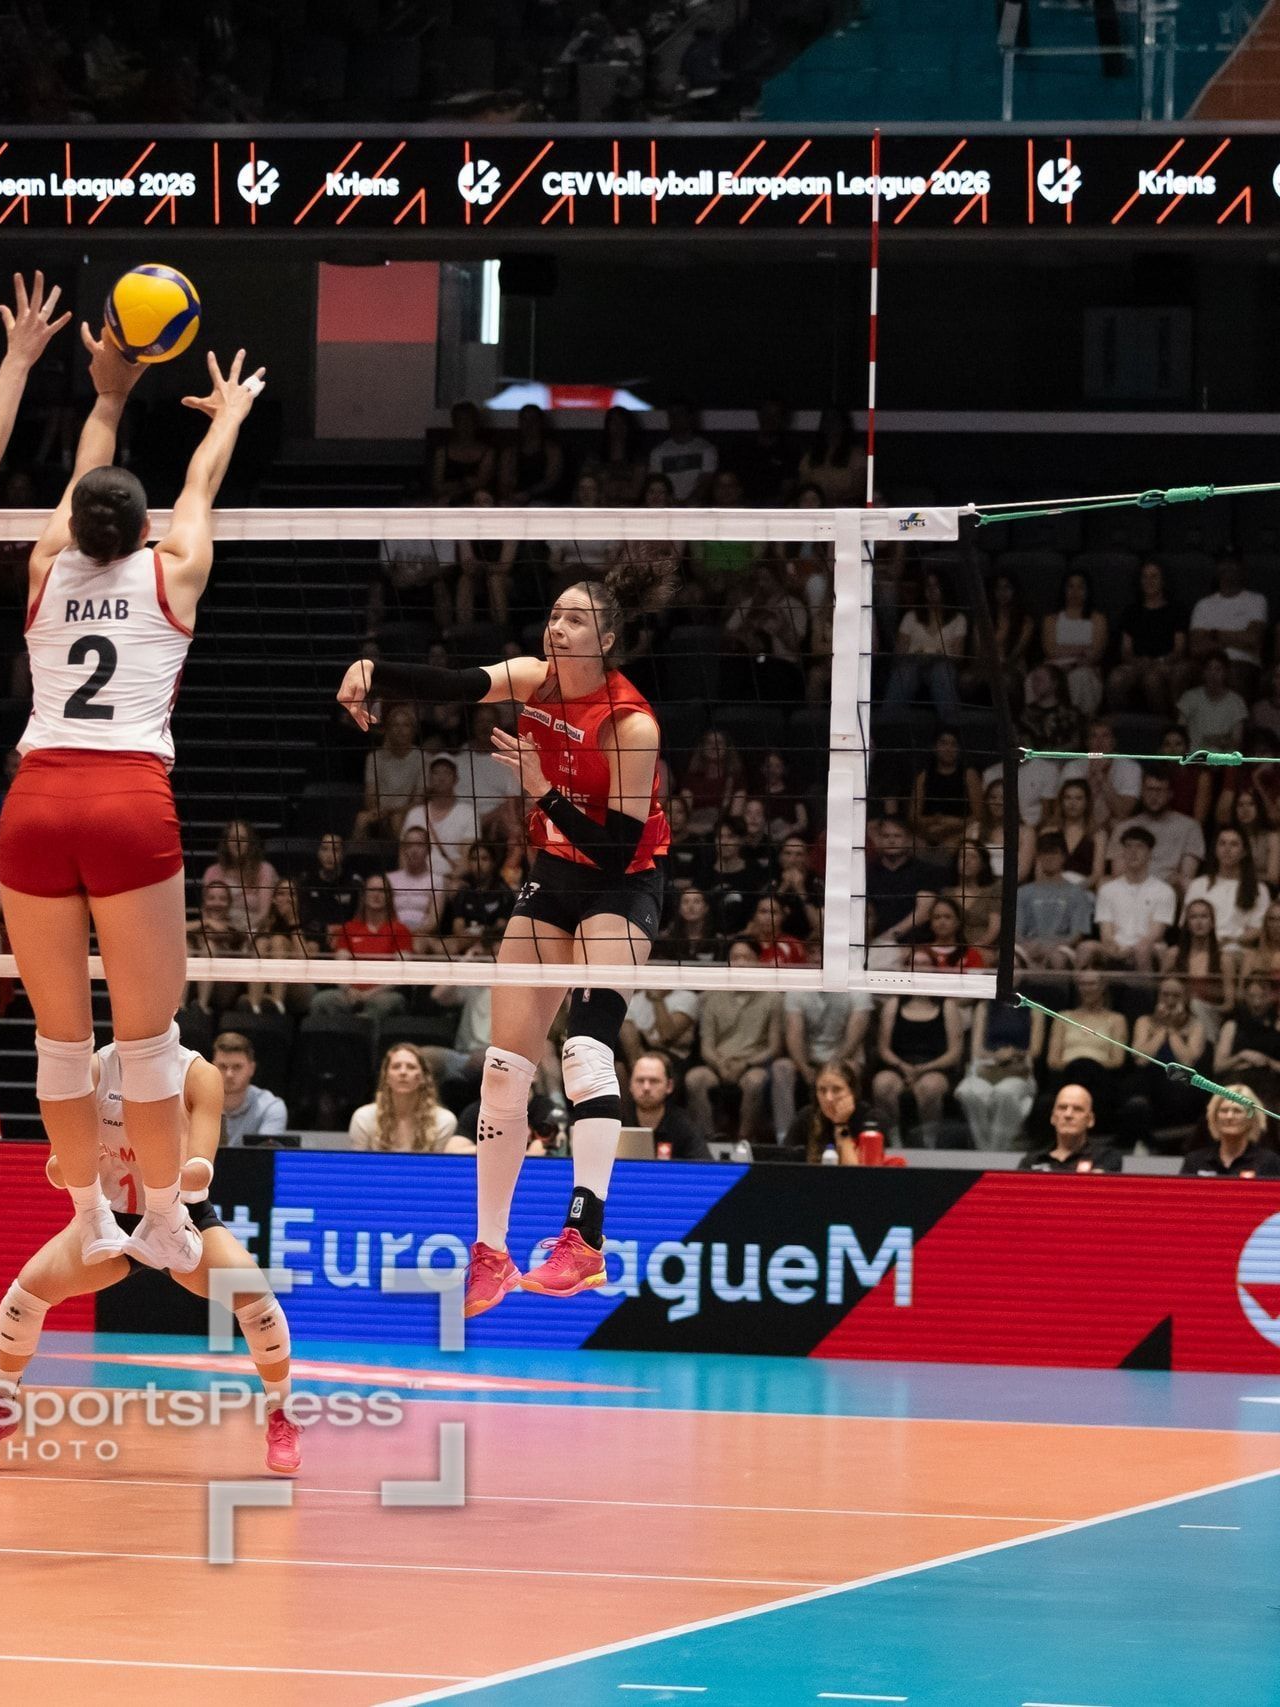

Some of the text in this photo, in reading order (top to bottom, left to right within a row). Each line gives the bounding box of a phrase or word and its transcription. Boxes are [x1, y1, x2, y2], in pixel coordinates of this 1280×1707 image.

[50, 173, 135, 202] League
[139, 172, 196, 197] 2026
[326, 171, 400, 196] Kriens
[542, 170, 991, 200] CEV Volleyball European League 2026
[1138, 169, 1216, 195] Kriens
[65, 599, 129, 622] RAAB
[63, 635, 118, 720] 2
[102, 1117, 125, 1128] CRAF
